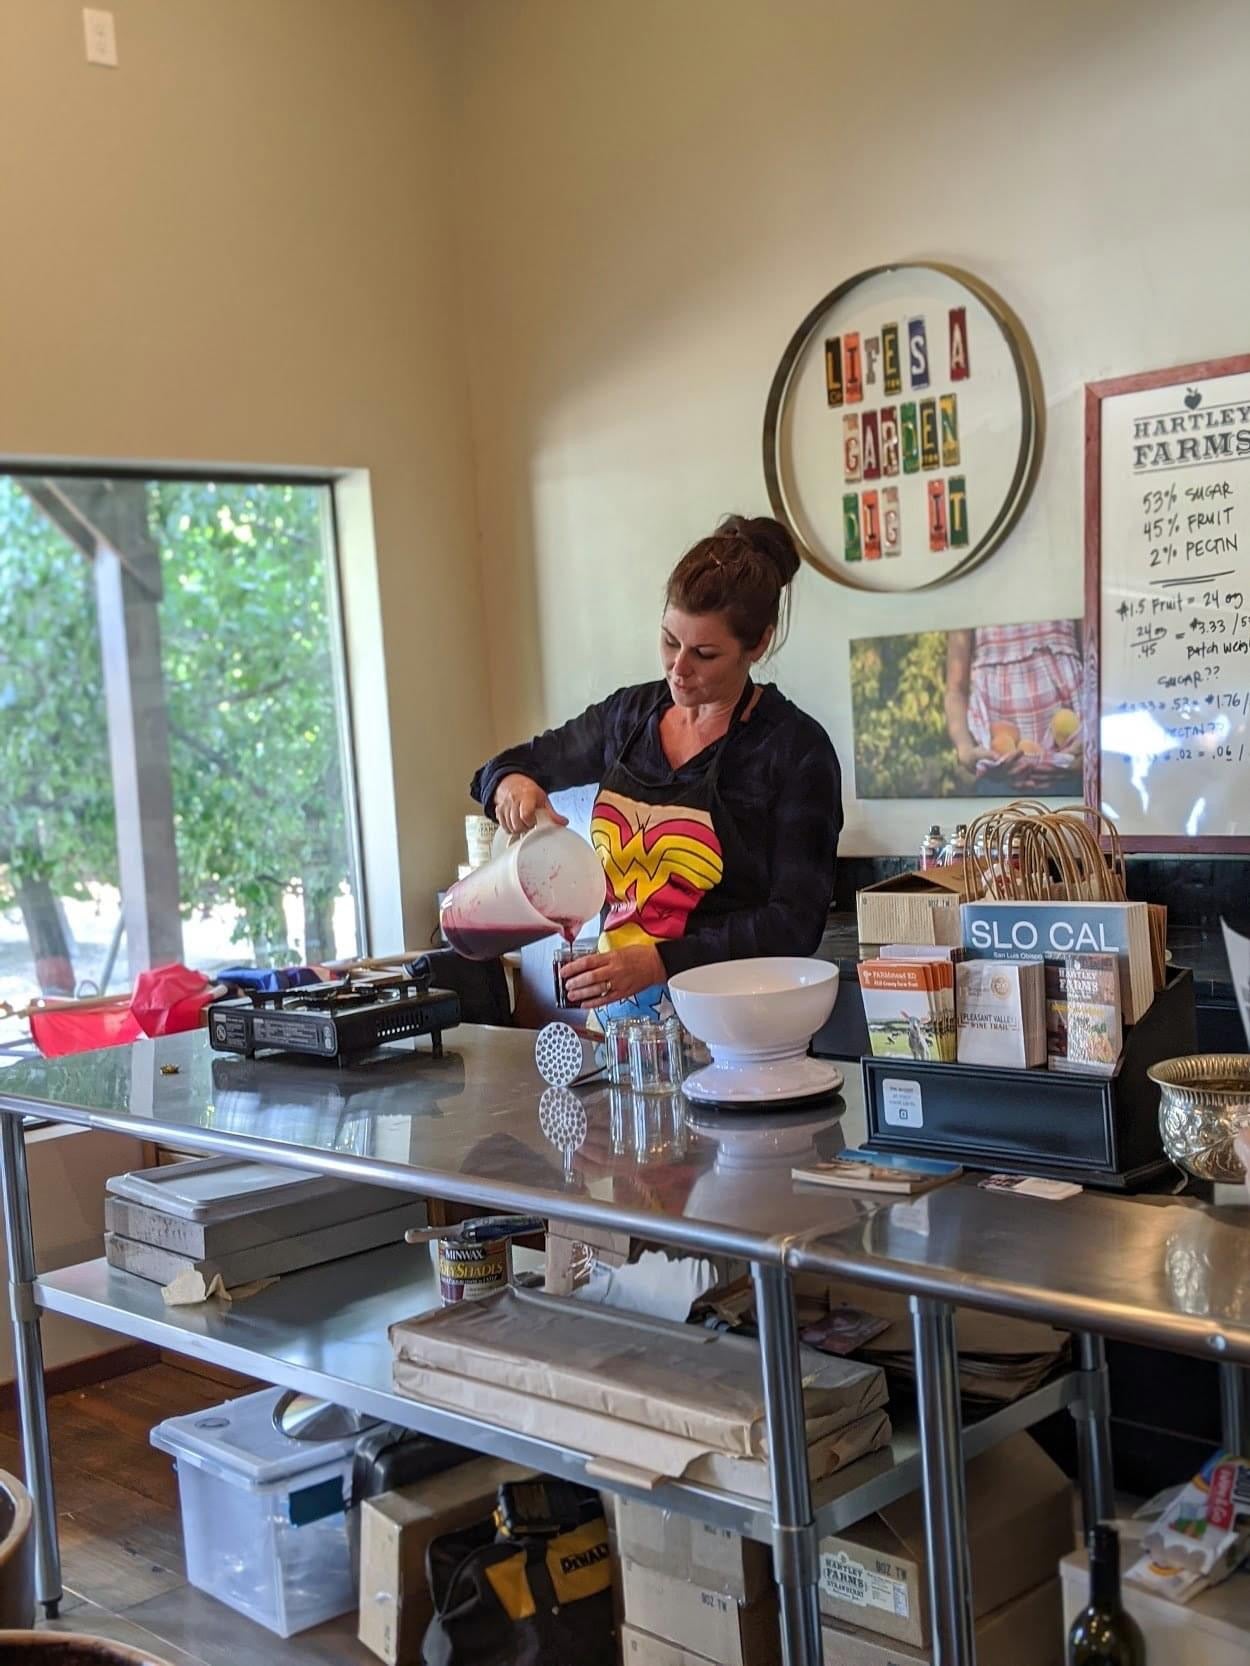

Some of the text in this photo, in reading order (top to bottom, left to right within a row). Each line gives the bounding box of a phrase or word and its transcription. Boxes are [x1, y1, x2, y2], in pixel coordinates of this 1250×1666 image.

[950, 316, 968, 376] A
[1133, 405, 1250, 440] HARTLEY
[844, 398, 959, 479] GARDEN
[1133, 429, 1250, 469] FARMS
[1143, 481, 1234, 515] 53% SUGAR
[845, 481, 966, 557] DIG IT
[1144, 507, 1235, 543] 45% FRUIT
[1149, 533, 1239, 568] 2% PECTIN
[1203, 590, 1220, 609] 24
[1136, 622, 1151, 640] 24
[971, 920, 1120, 952] SLO CAL
[993, 951, 1006, 959] San
[1007, 952, 1020, 960] Luis
[1059, 967, 1097, 980] HARTLEY
[1060, 979, 1098, 993] FARMS
[963, 1013, 992, 1022] PLEASANT
[990, 1023, 1009, 1031] TRAIL
[445, 1248, 484, 1261] MINWAX
[826, 1559, 864, 1577] HARTLEY
[826, 1568, 865, 1588] FARMS
